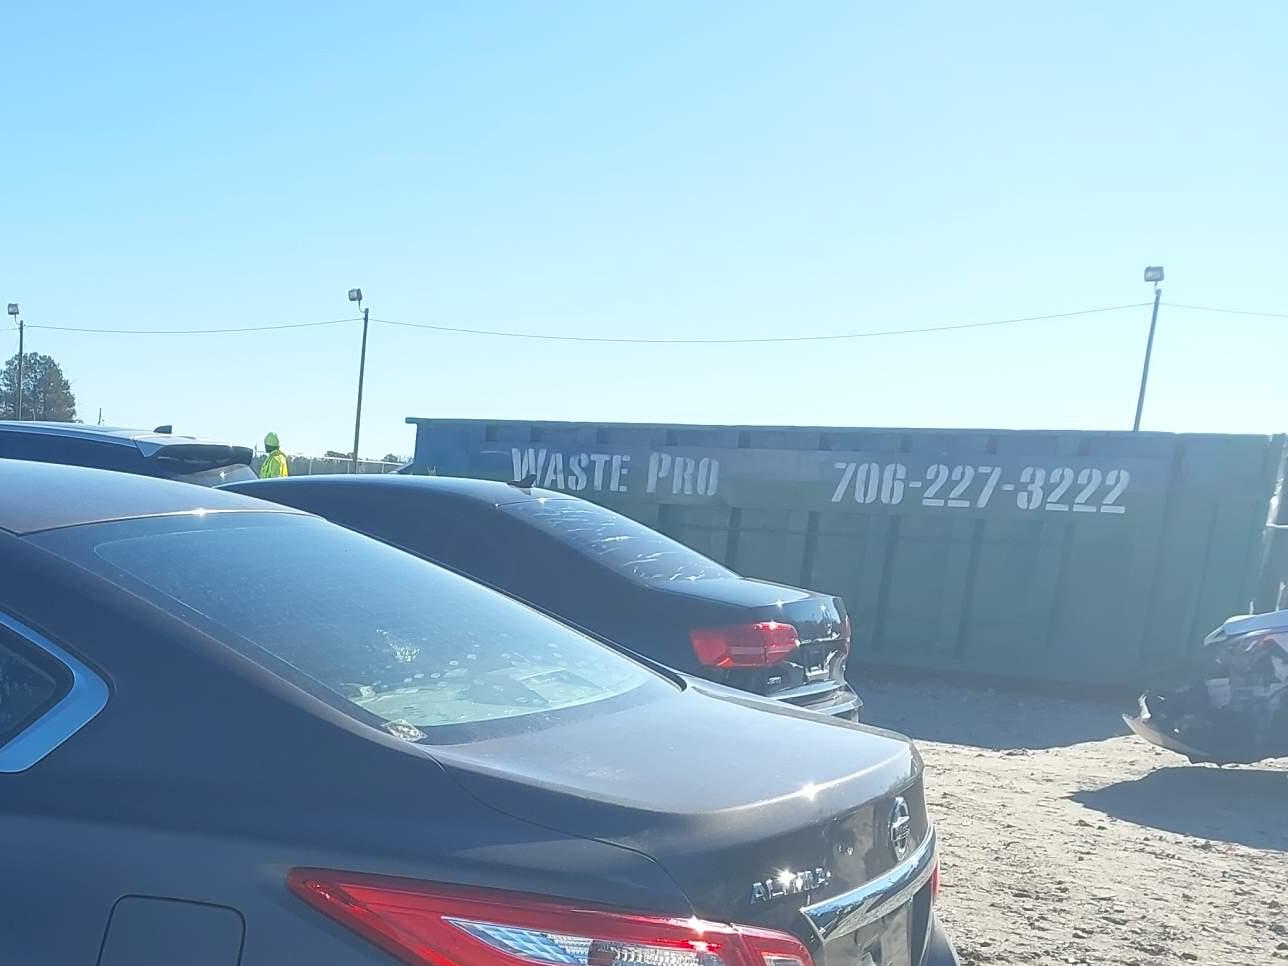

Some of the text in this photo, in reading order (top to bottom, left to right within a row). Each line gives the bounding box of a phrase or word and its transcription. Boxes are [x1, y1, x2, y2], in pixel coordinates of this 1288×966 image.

[512, 447, 720, 497] WASTE PRO
[831, 462, 1130, 514] 706-227-3222
